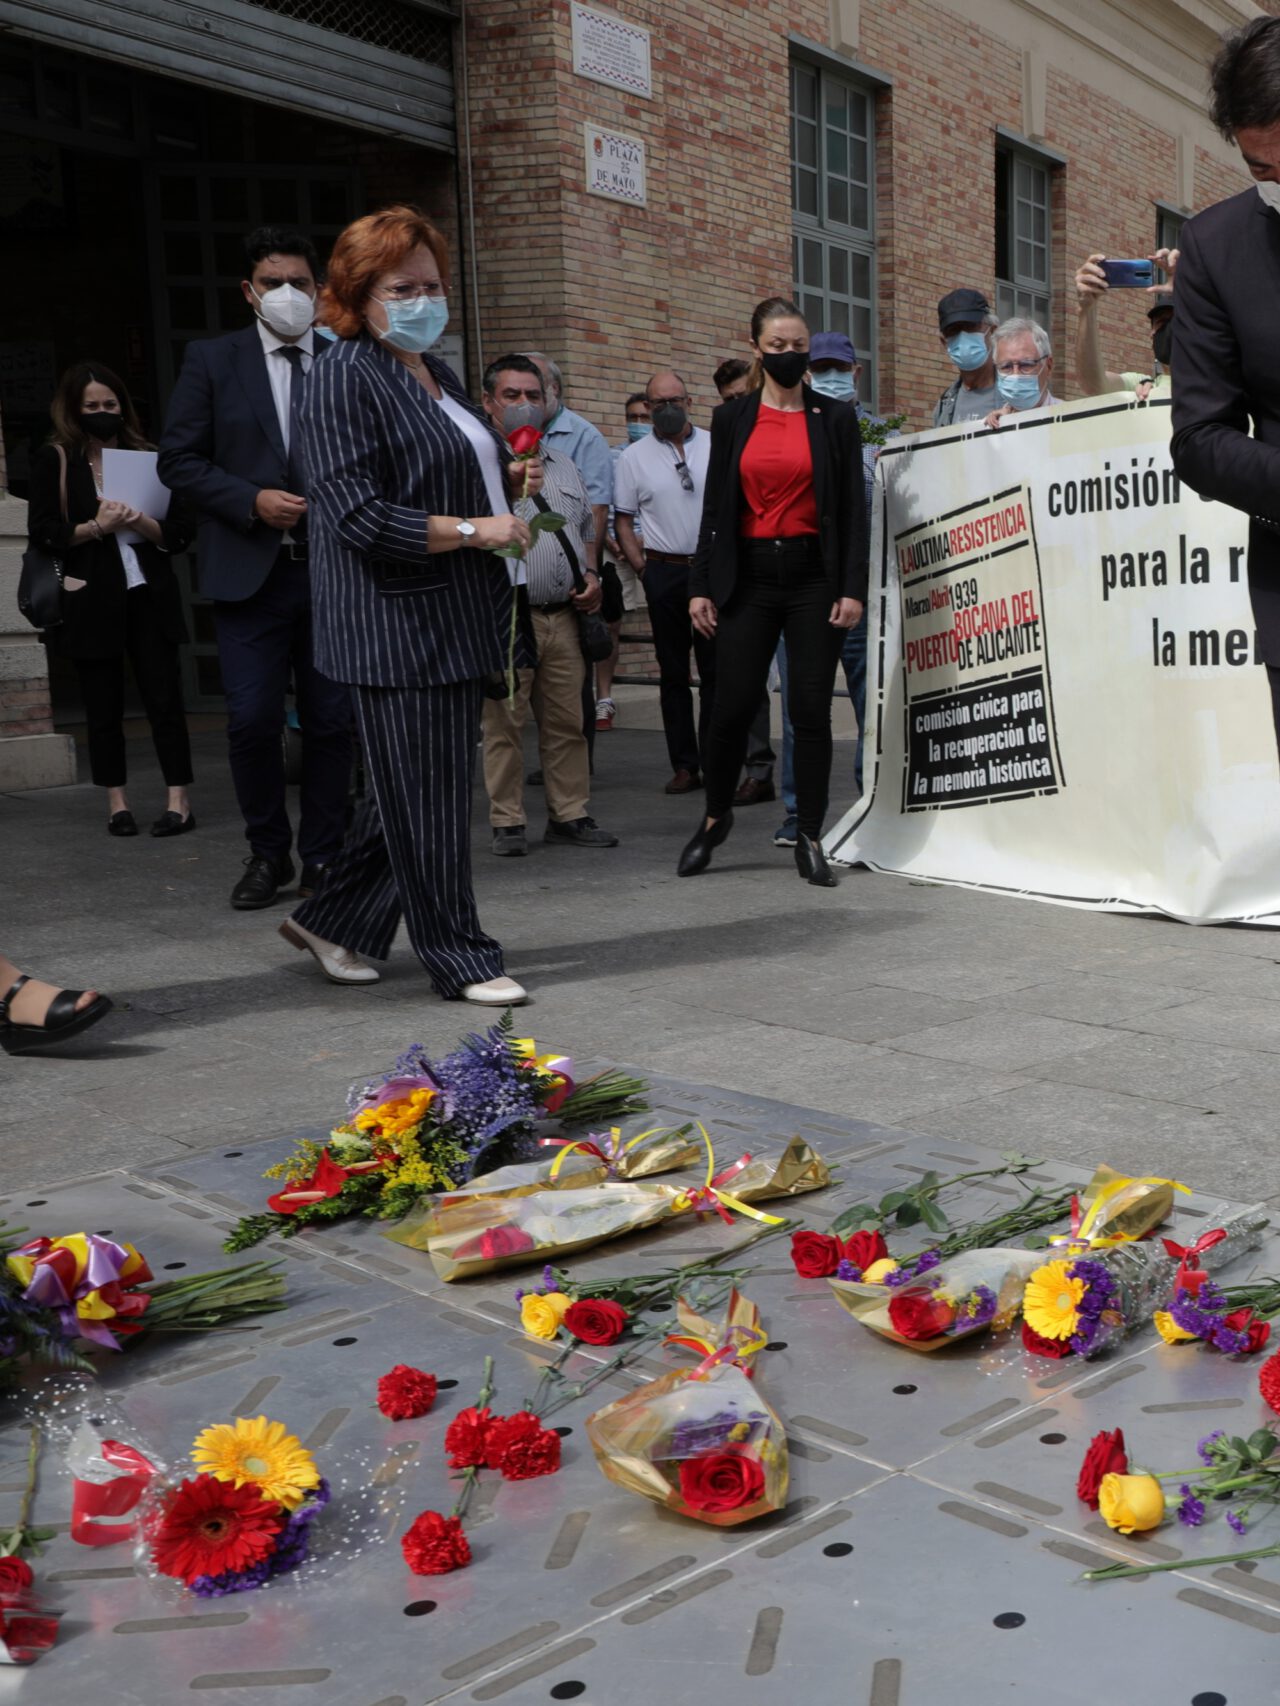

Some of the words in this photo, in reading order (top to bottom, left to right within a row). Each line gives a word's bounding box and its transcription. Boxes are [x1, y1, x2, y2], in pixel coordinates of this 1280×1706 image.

[610, 144, 639, 164] PLAZA
[620, 161, 630, 174] 25
[596, 169, 608, 182] DE
[612, 172, 635, 190] MAYO
[1048, 457, 1181, 517] comisión
[1101, 549, 1167, 601] para
[1179, 534, 1210, 585] la
[1228, 546, 1245, 583] r
[954, 598, 1009, 641] BOCANA
[1012, 590, 1039, 625] DEL
[906, 629, 959, 674] PUERTO
[958, 637, 974, 671] DE
[977, 620, 1041, 666] ALICANTE
[1152, 617, 1176, 667] la
[1188, 629, 1266, 667] me
[915, 701, 970, 733] comisión
[972, 692, 1008, 722] cívica
[1012, 688, 1043, 719] para
[929, 738, 941, 762] la
[944, 722, 1025, 761] recuperación
[1027, 717, 1047, 744] de
[913, 772, 928, 795] la
[932, 762, 986, 793] memoria
[988, 753, 1051, 785] histórica
